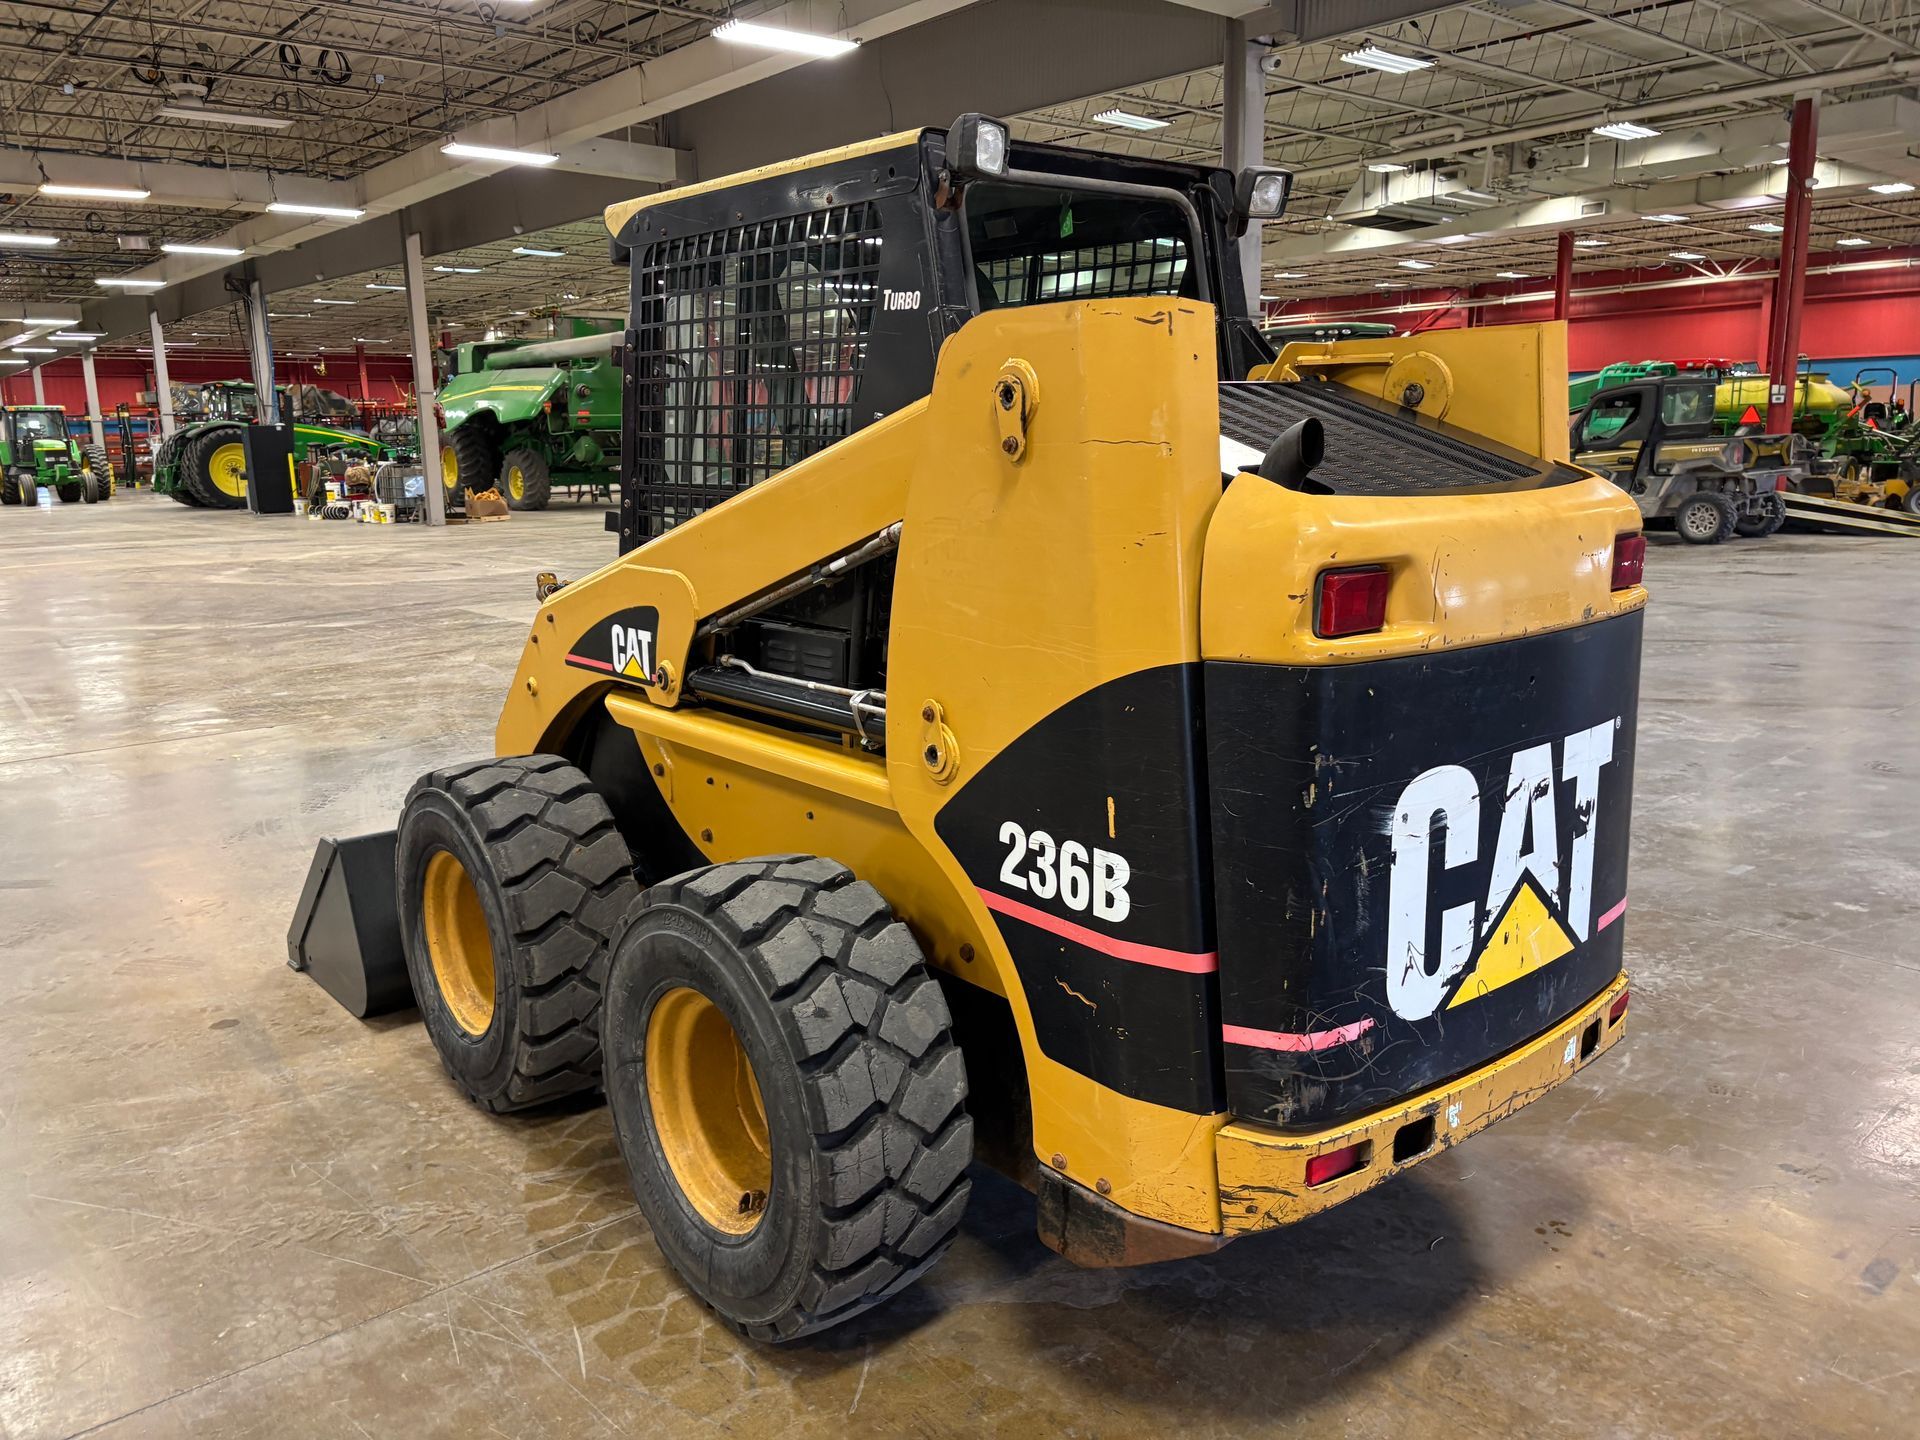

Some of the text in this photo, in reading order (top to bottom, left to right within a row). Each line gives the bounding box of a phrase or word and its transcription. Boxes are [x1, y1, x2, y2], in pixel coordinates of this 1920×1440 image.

[883, 289, 921, 311] TURBO
[611, 623, 652, 681] CAT
[999, 820, 1131, 923] 236B
[1386, 718, 1615, 1022] CAT
